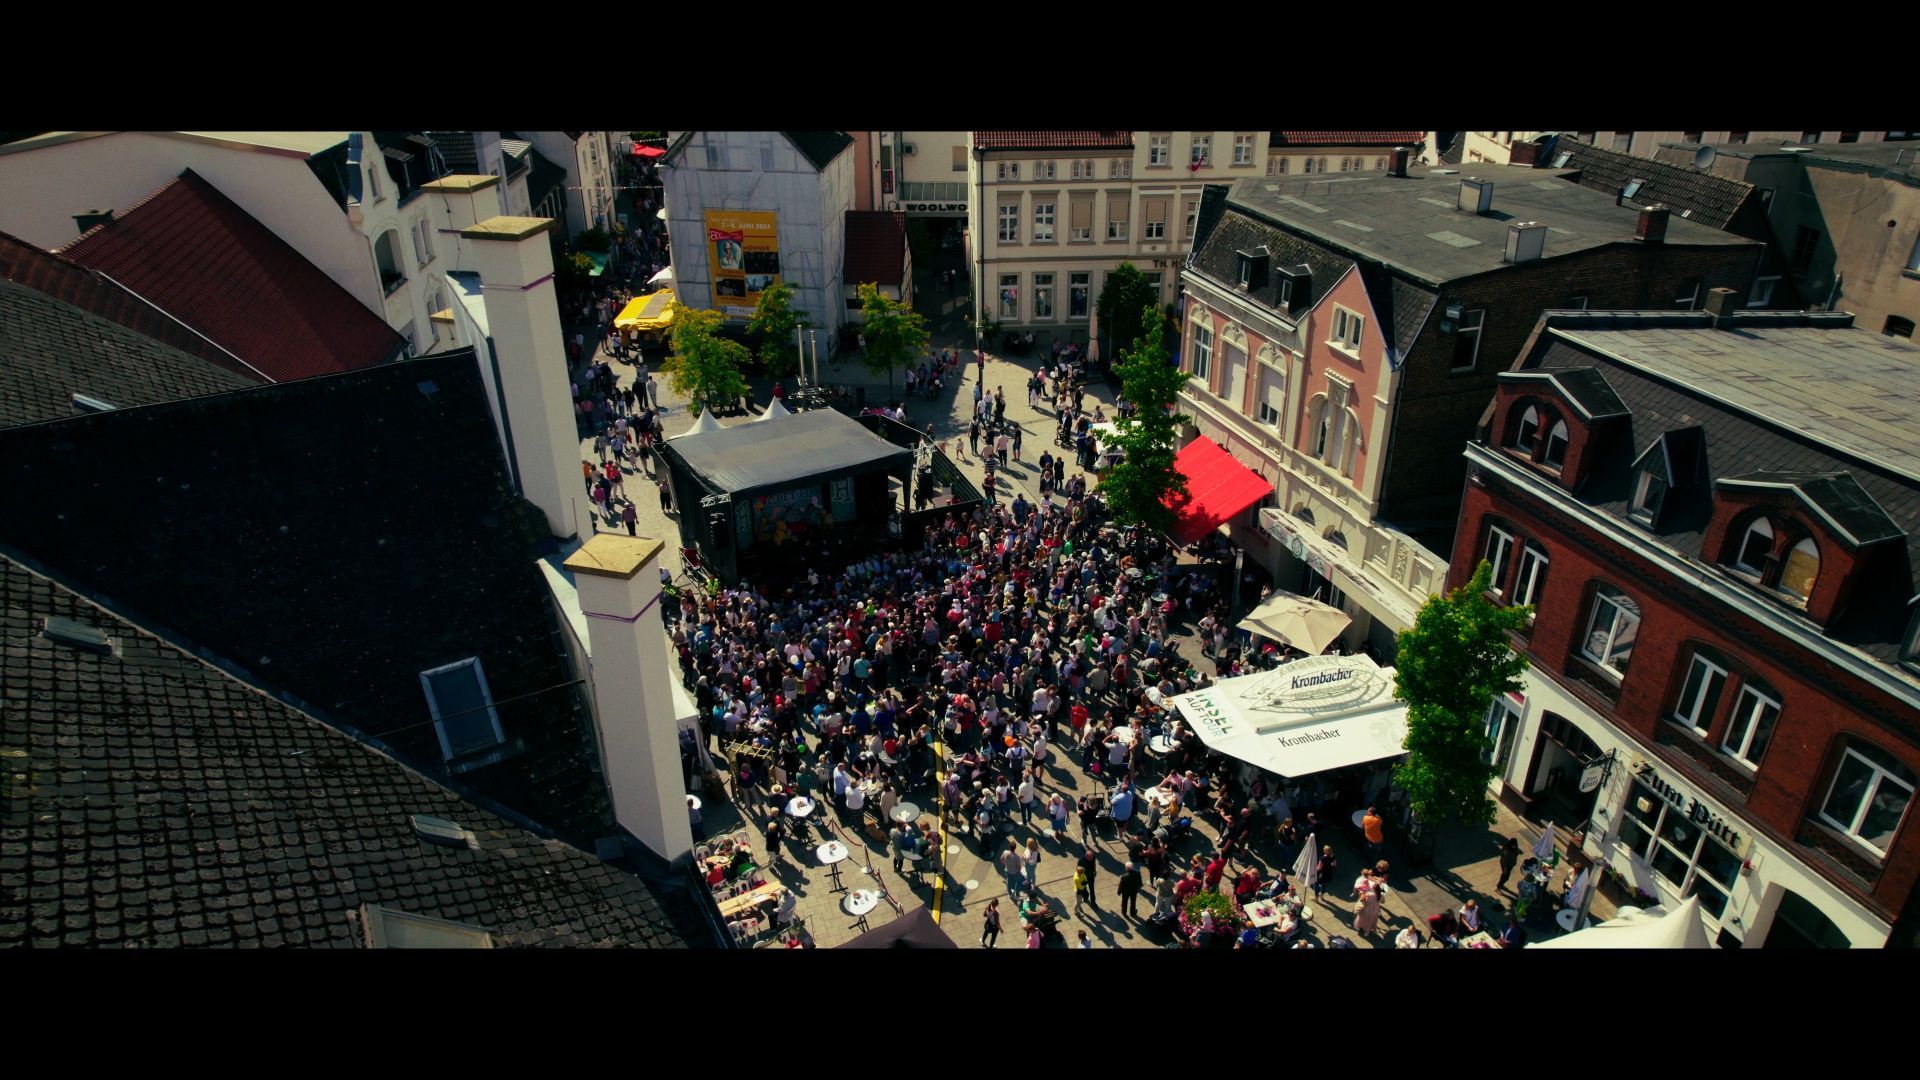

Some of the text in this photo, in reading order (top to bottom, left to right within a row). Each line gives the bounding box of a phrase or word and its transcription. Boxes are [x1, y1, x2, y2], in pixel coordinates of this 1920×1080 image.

[906, 203, 967, 211] WOOLWO
[1291, 668, 1354, 690] Krombacher
[1195, 693, 1233, 734] INSEL
[1278, 727, 1342, 748] Krombacher
[1635, 760, 1683, 807] Zum
